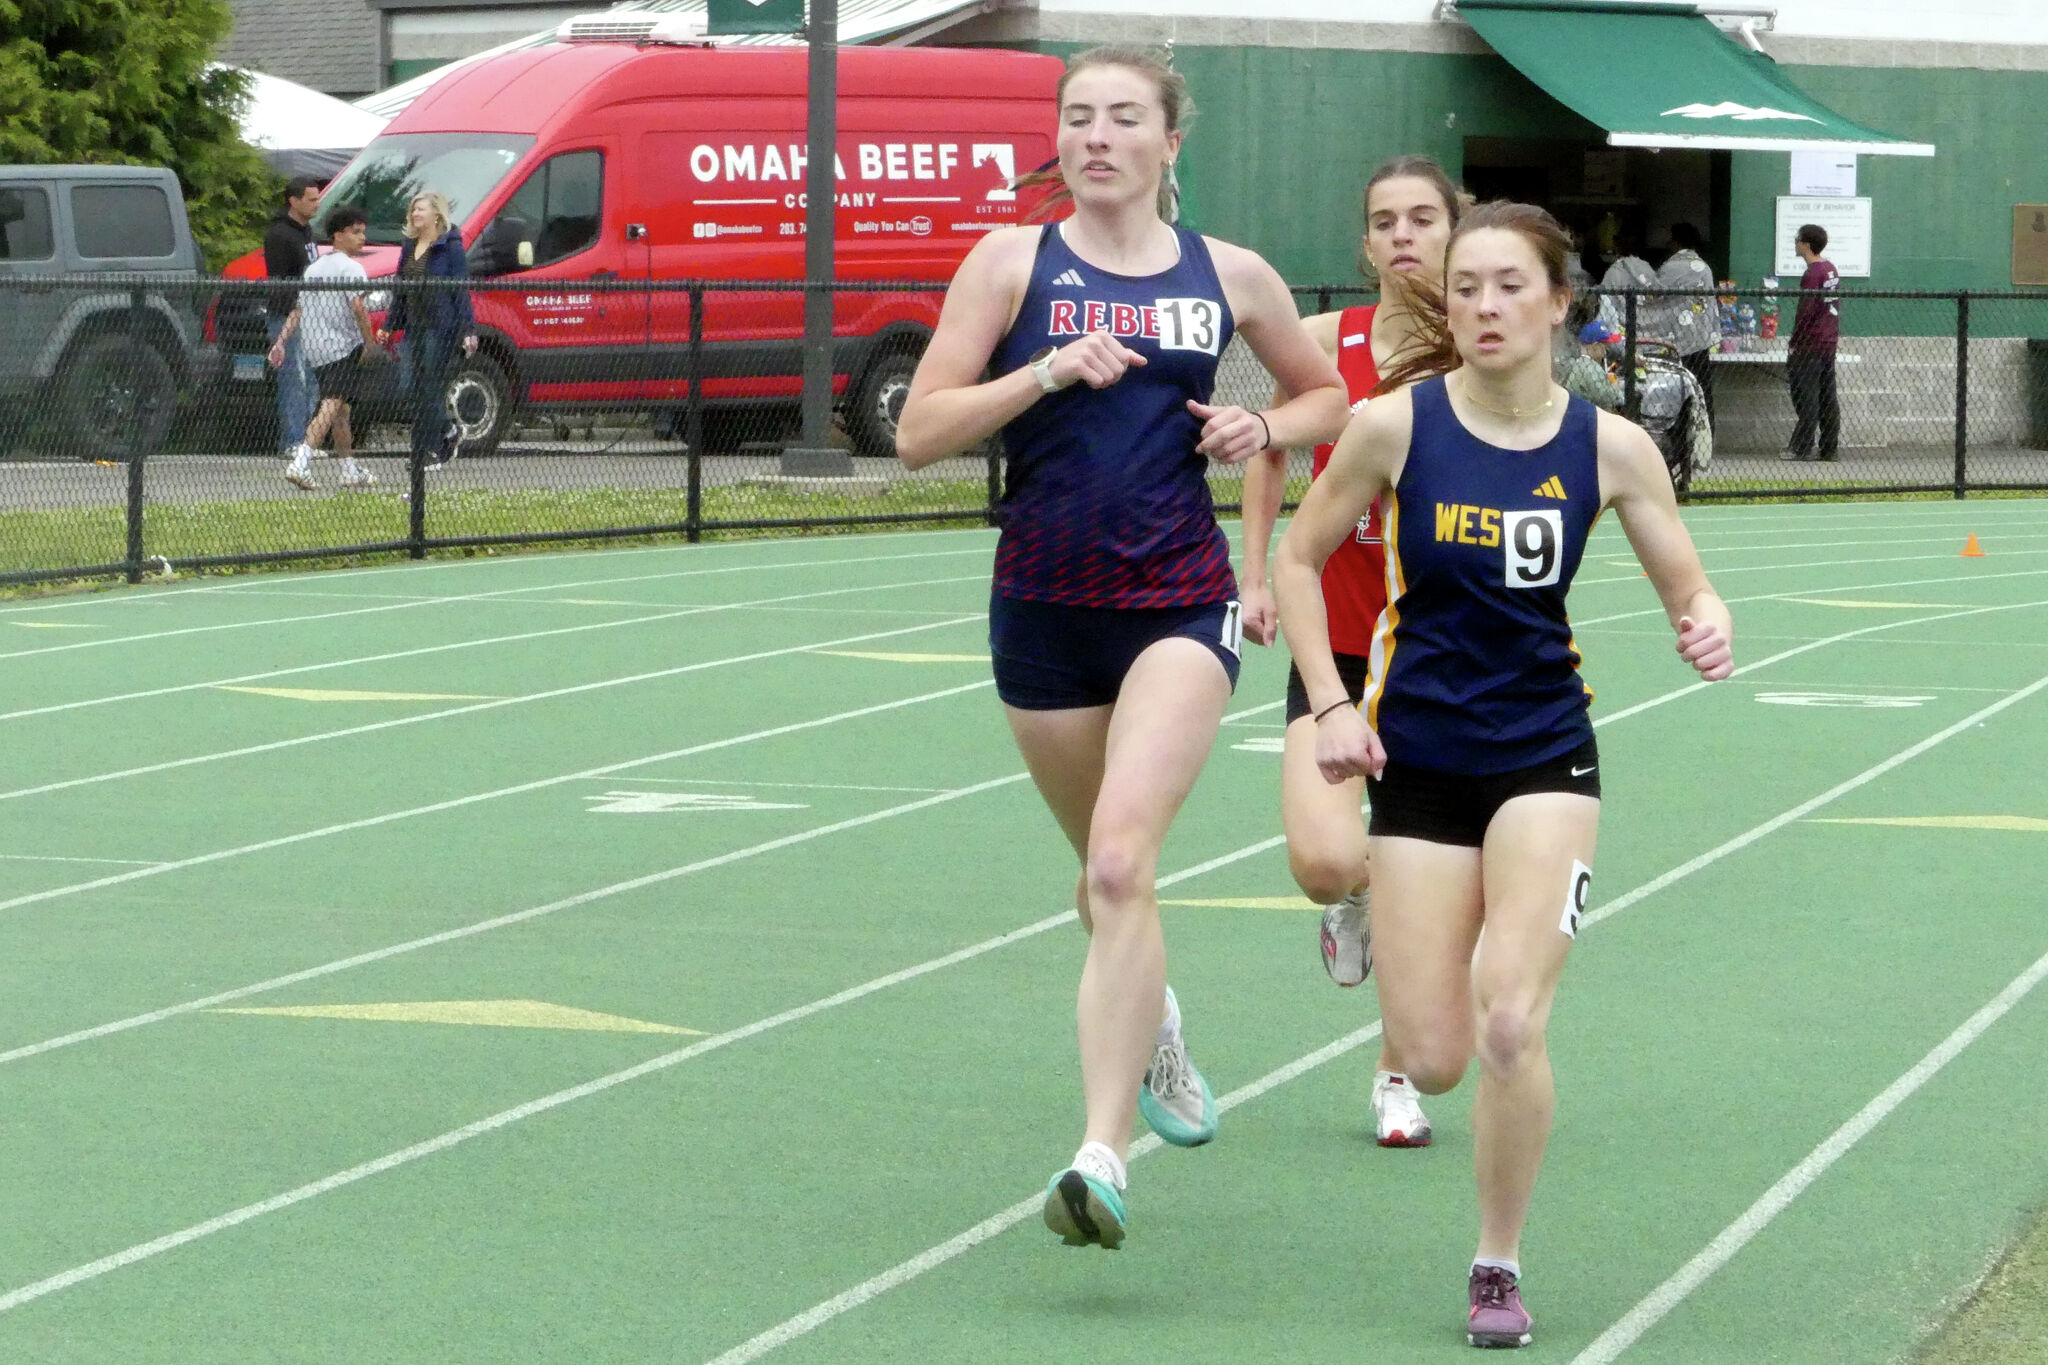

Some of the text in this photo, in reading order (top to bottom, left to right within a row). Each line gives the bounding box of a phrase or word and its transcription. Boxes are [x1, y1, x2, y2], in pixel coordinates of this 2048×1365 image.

[858, 143, 958, 180] BEEF
[784, 192, 876, 208] COANY
[975, 205, 992, 214] EST
[853, 220, 930, 233] Quality You Can Trust
[1048, 300, 1161, 339] REBE
[1163, 301, 1213, 350] 13
[1435, 502, 1501, 548] WES
[1514, 516, 1556, 582] 9
